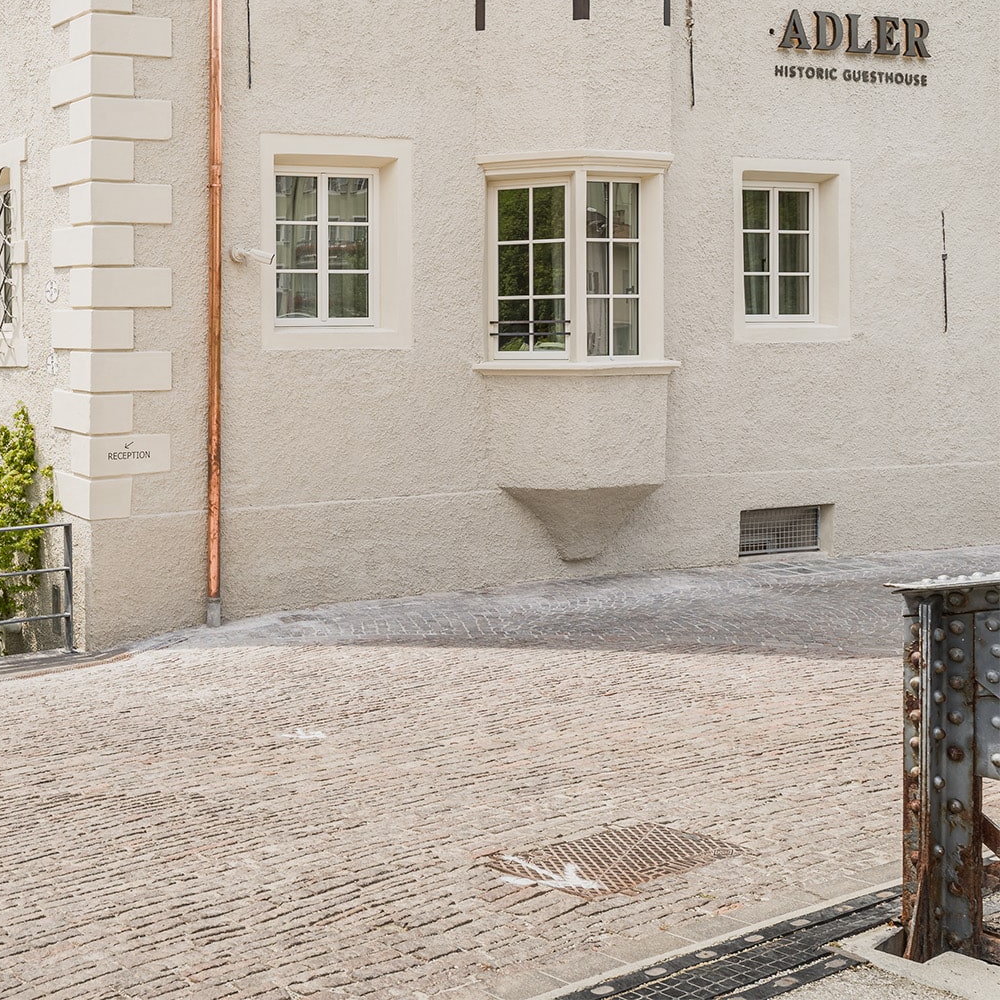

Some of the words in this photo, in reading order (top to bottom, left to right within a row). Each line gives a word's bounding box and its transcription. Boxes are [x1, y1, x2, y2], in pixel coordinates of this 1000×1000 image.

[778, 9, 931, 58] ADLER
[775, 65, 837, 81] HISTORIC
[843, 69, 928, 86] GUESTHOUSE
[108, 451, 150, 460] RECEPTION
